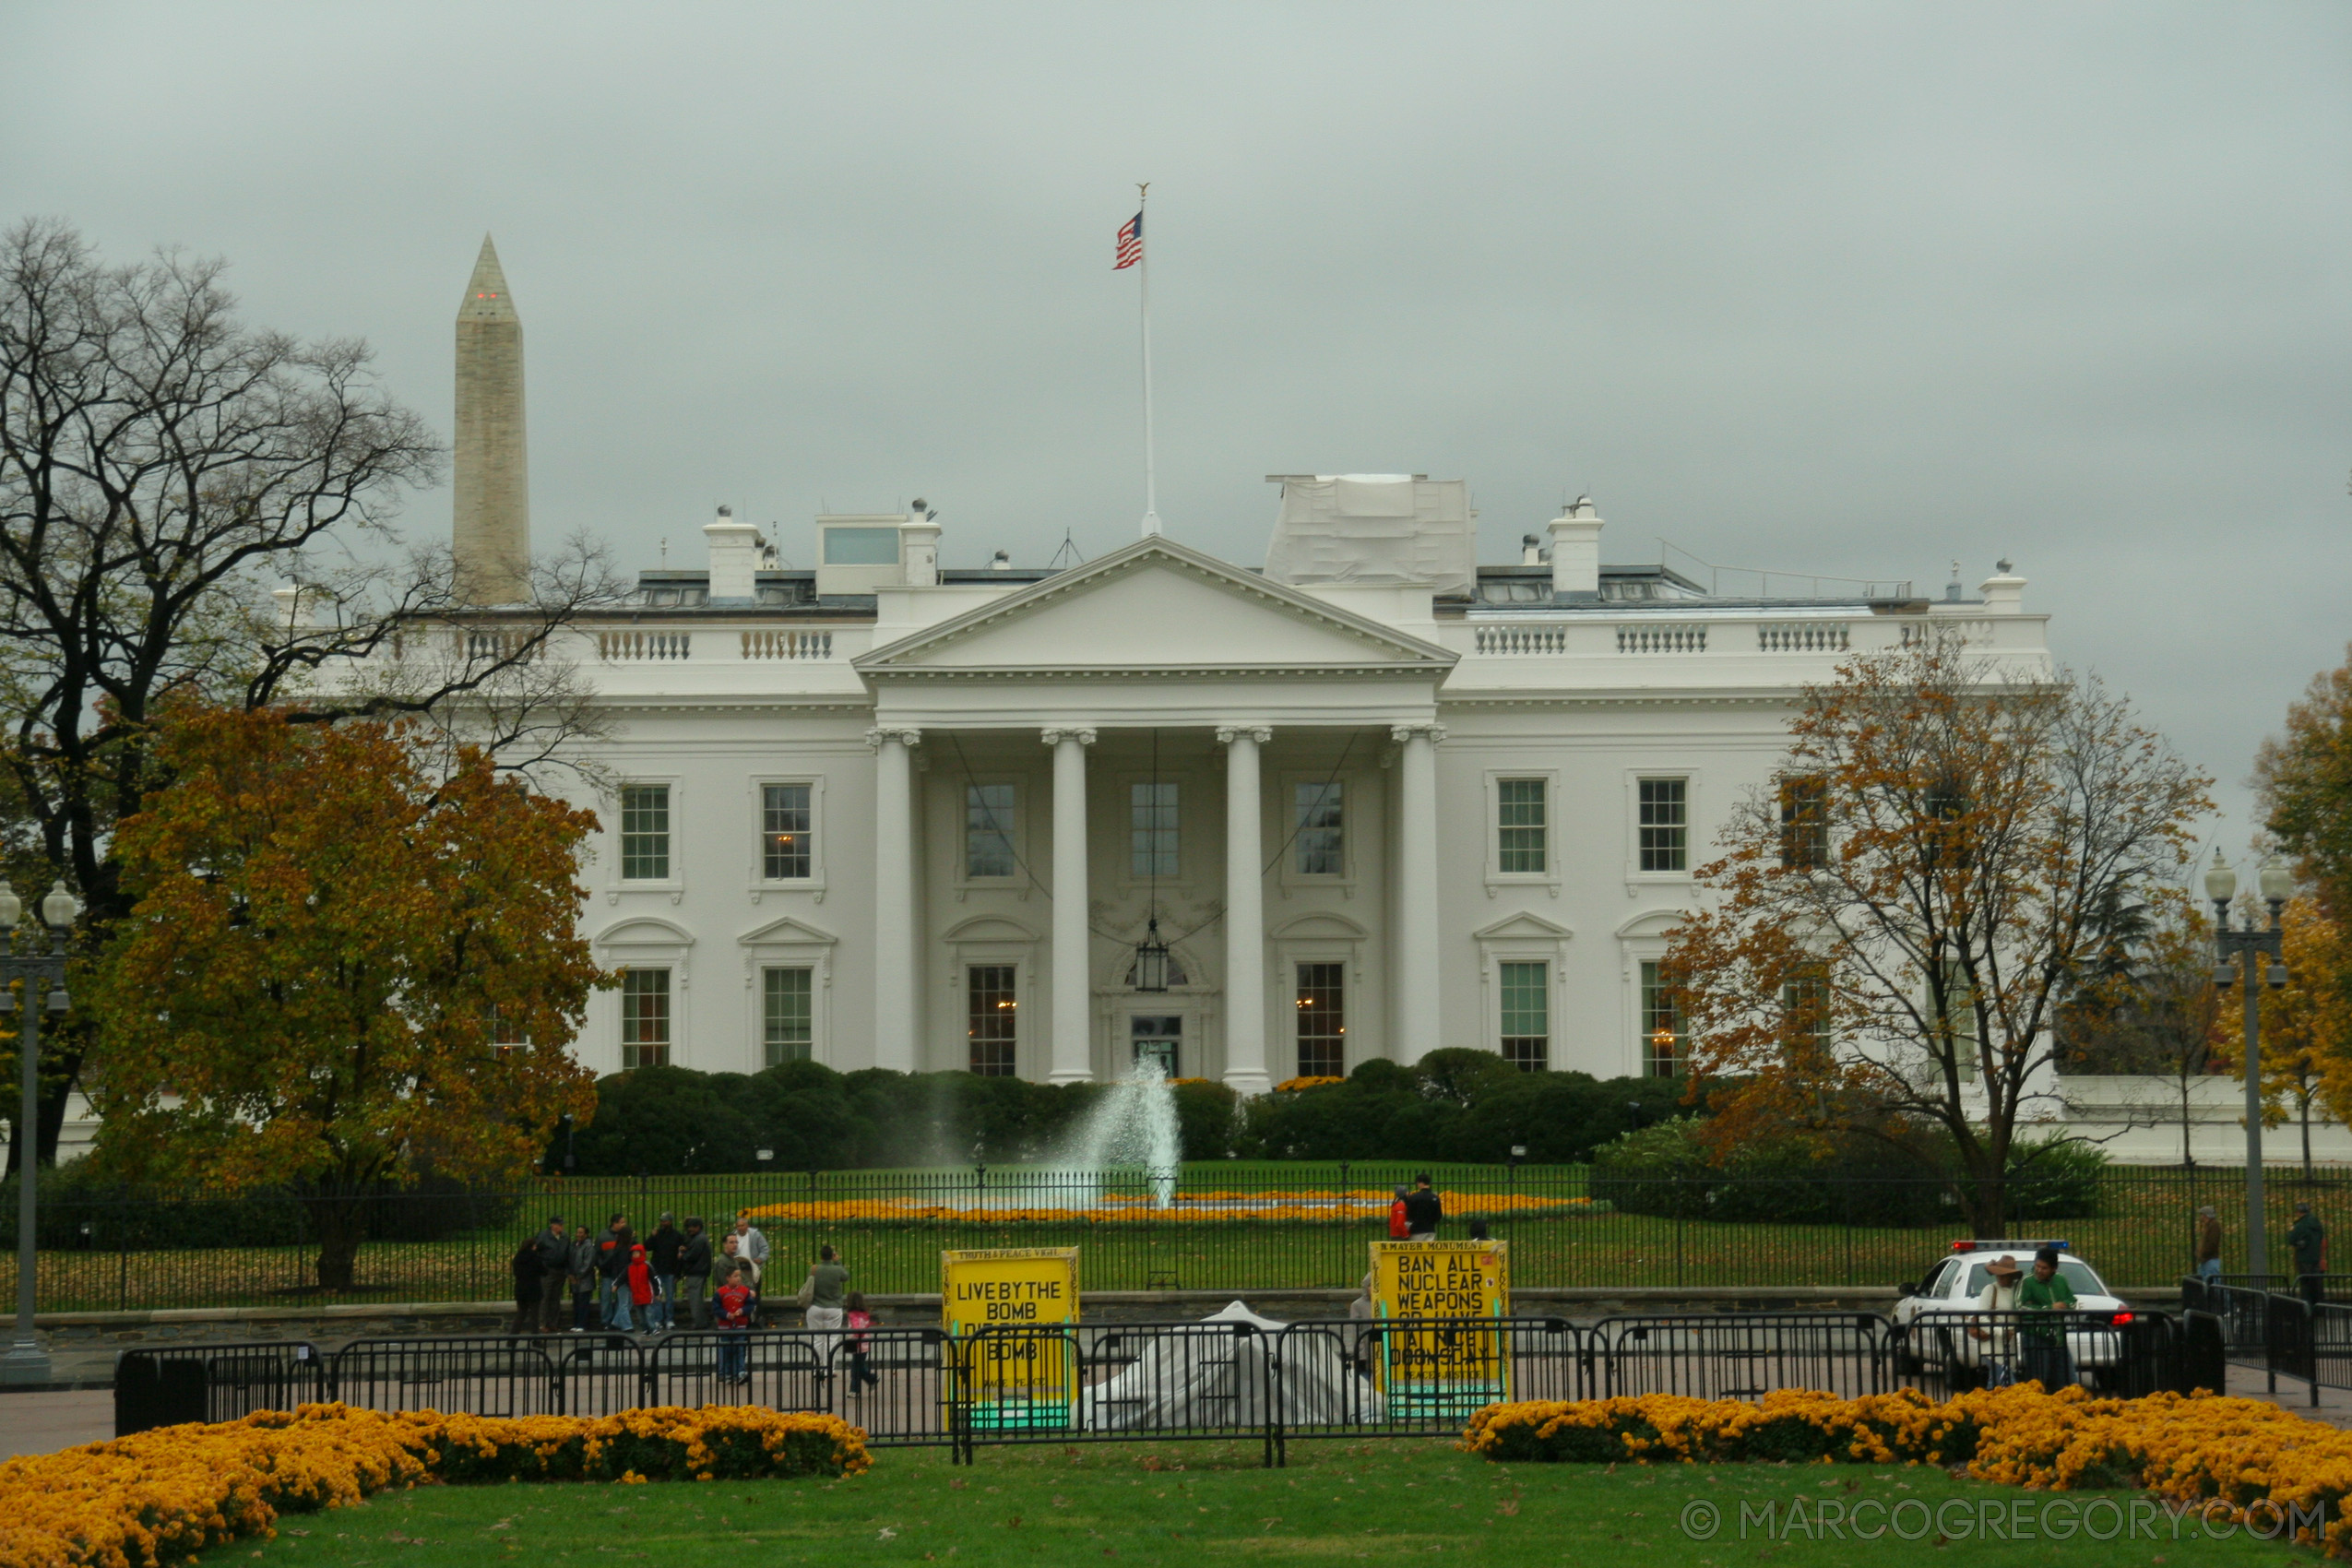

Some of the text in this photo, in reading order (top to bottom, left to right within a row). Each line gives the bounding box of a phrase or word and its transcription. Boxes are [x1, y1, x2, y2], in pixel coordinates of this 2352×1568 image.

[959, 1251, 992, 1260] TRUTH
[999, 1250, 1031, 1258] PEACE
[1034, 1248, 1060, 1257] VIGIL
[1389, 1242, 1422, 1251] MAYER
[1427, 1241, 1483, 1251] MONUMENT
[1398, 1255, 1435, 1273] BAN
[1447, 1254, 1481, 1272] ALL
[943, 1265, 952, 1306] SINCE
[957, 1281, 1061, 1301] LIVE BY THE
[1398, 1274, 1482, 1291] NUCLEAR
[1397, 1292, 1482, 1310] WEAPONS
[987, 1302, 1036, 1320] BOMB
[1435, 1328, 1476, 1347] NCE
[988, 1343, 1037, 1360] BOMB
